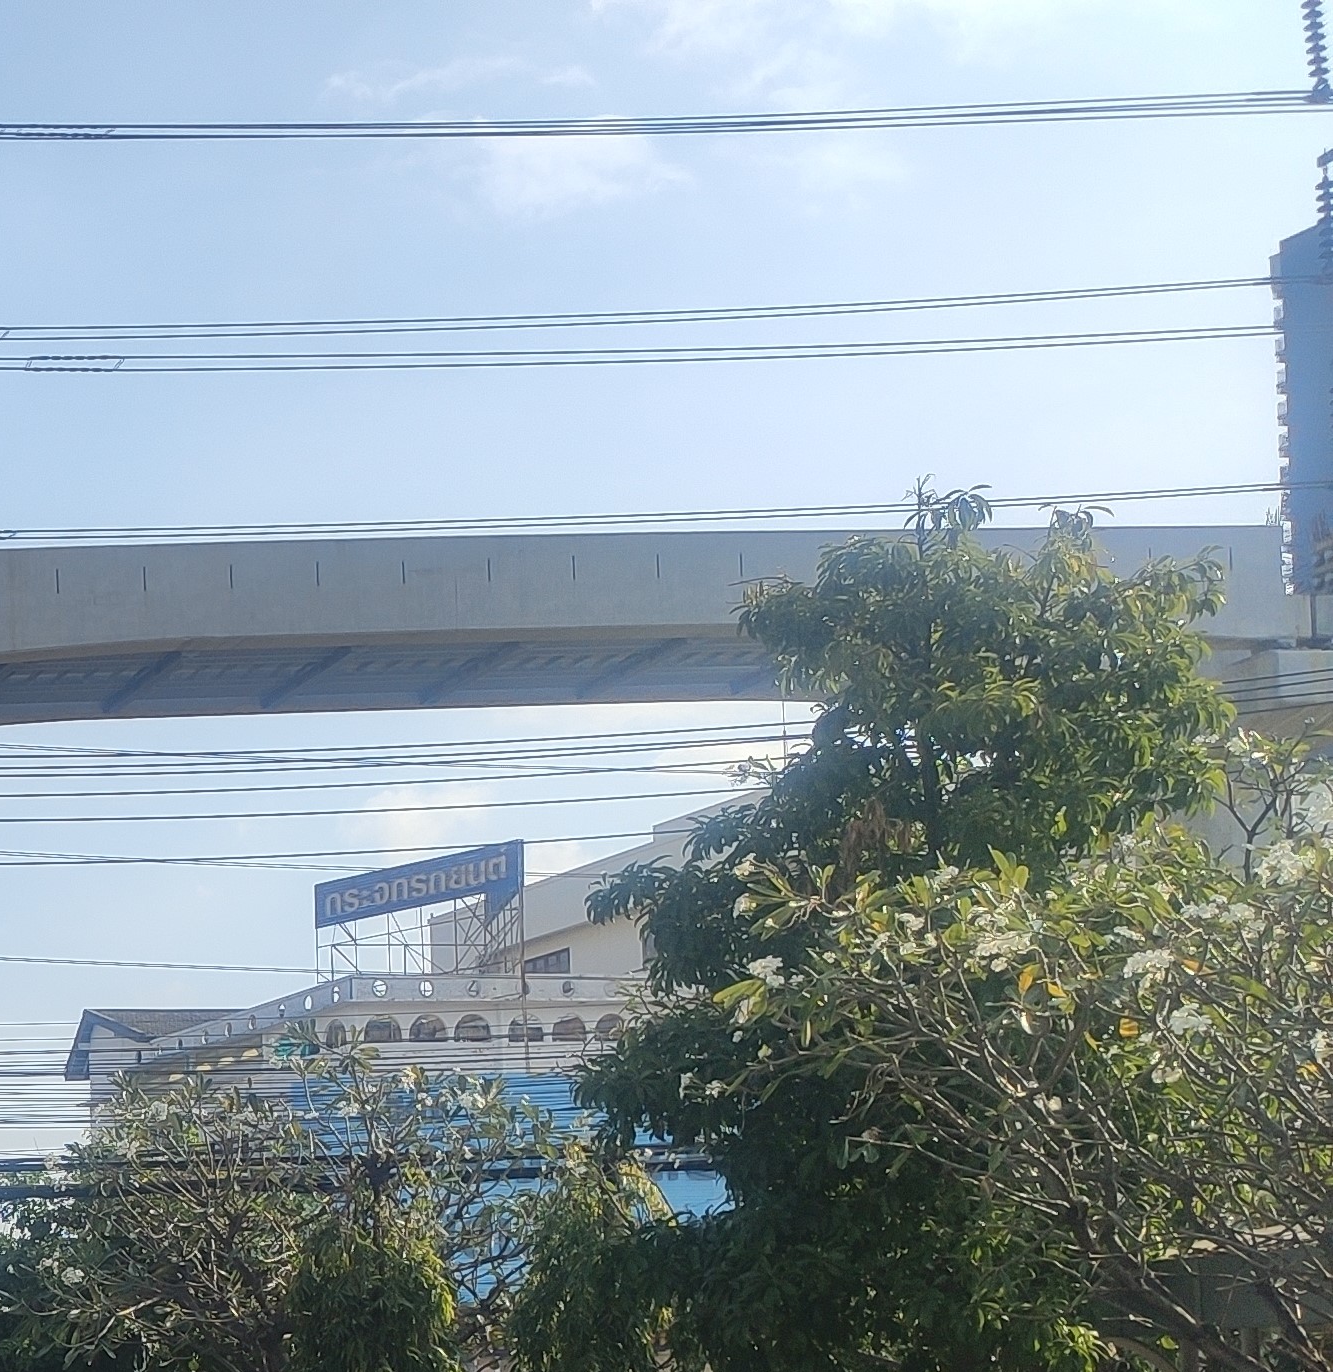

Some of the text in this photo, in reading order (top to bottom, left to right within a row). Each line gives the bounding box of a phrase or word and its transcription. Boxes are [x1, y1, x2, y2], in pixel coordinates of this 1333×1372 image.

[325, 846, 508, 918] กระจกรถยนต์
